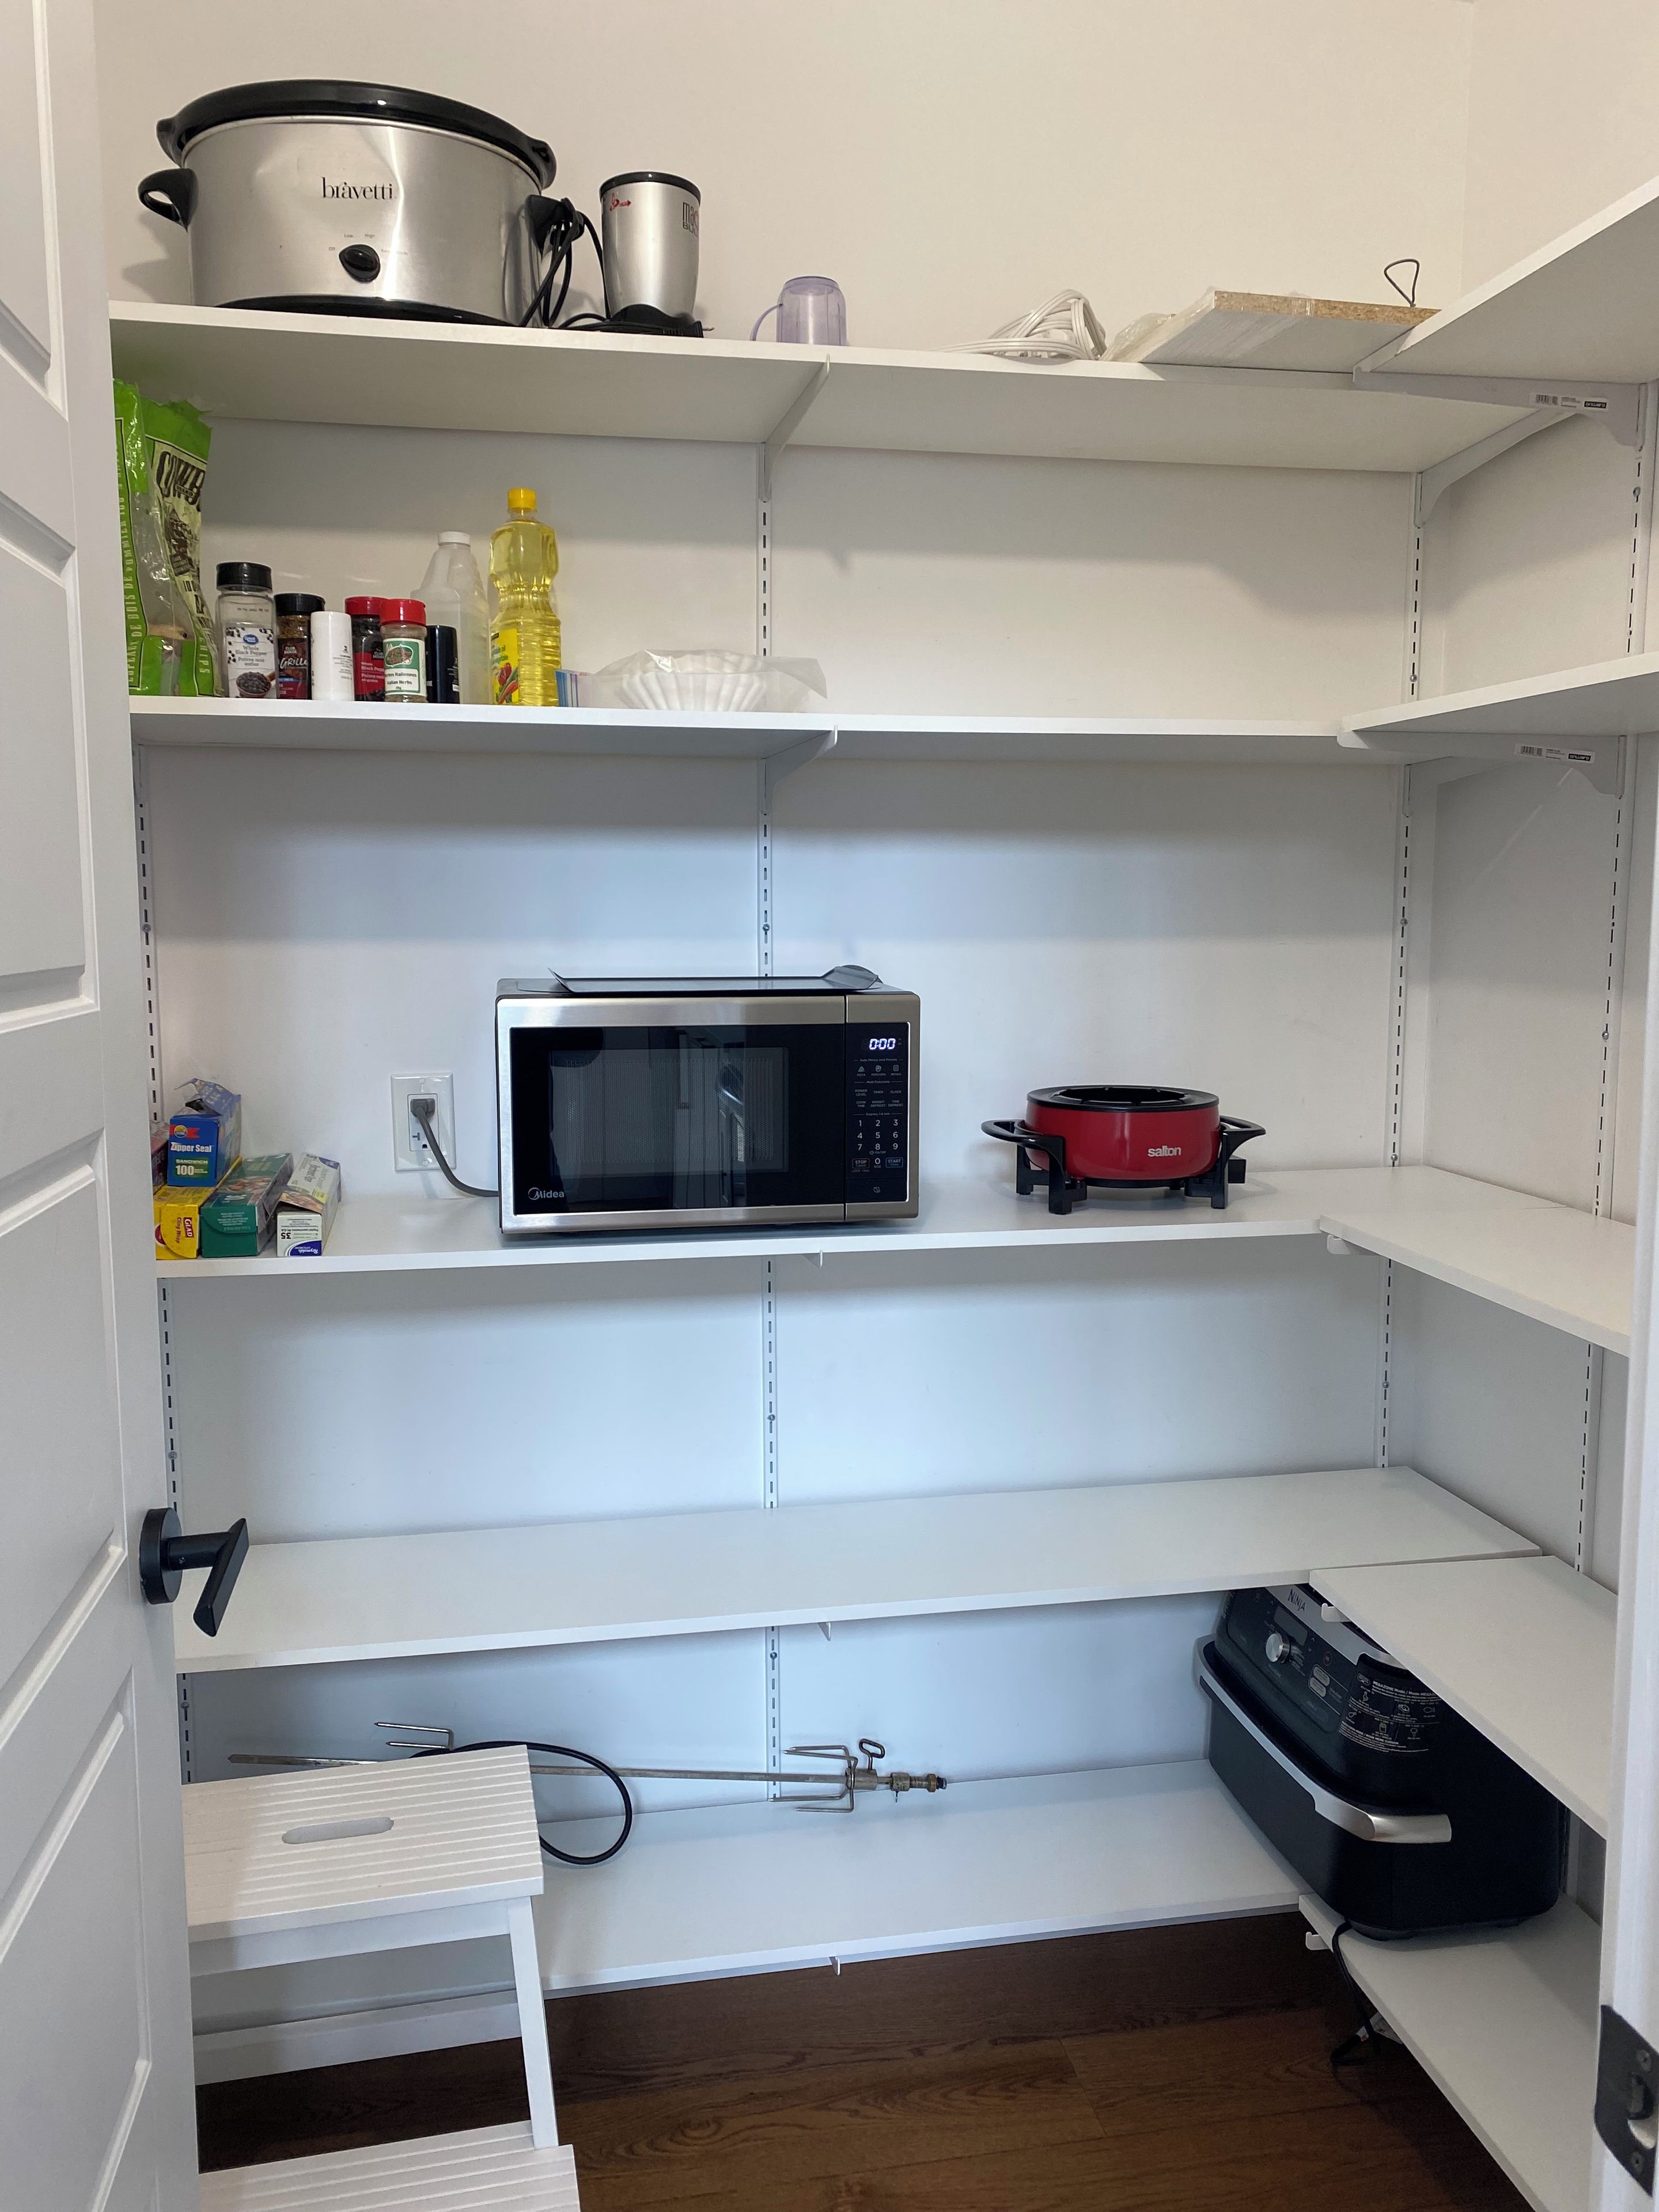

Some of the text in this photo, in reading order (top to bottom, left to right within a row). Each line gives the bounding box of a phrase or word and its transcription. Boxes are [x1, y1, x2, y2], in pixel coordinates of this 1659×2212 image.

[321, 177, 393, 200] bravetti
[126, 594, 140, 620] BOIS
[869, 1038, 896, 1050] 0:00
[171, 1142, 212, 1153] Zipper Seal
[1147, 1145, 1181, 1157] salton
[175, 1165, 195, 1175] 100
[528, 1187, 565, 1200] Midea
[184, 1218, 193, 1237] GLAD
[1287, 1588, 1305, 1612] NINJA
[1373, 1681, 1394, 1691] MEGAZONE
